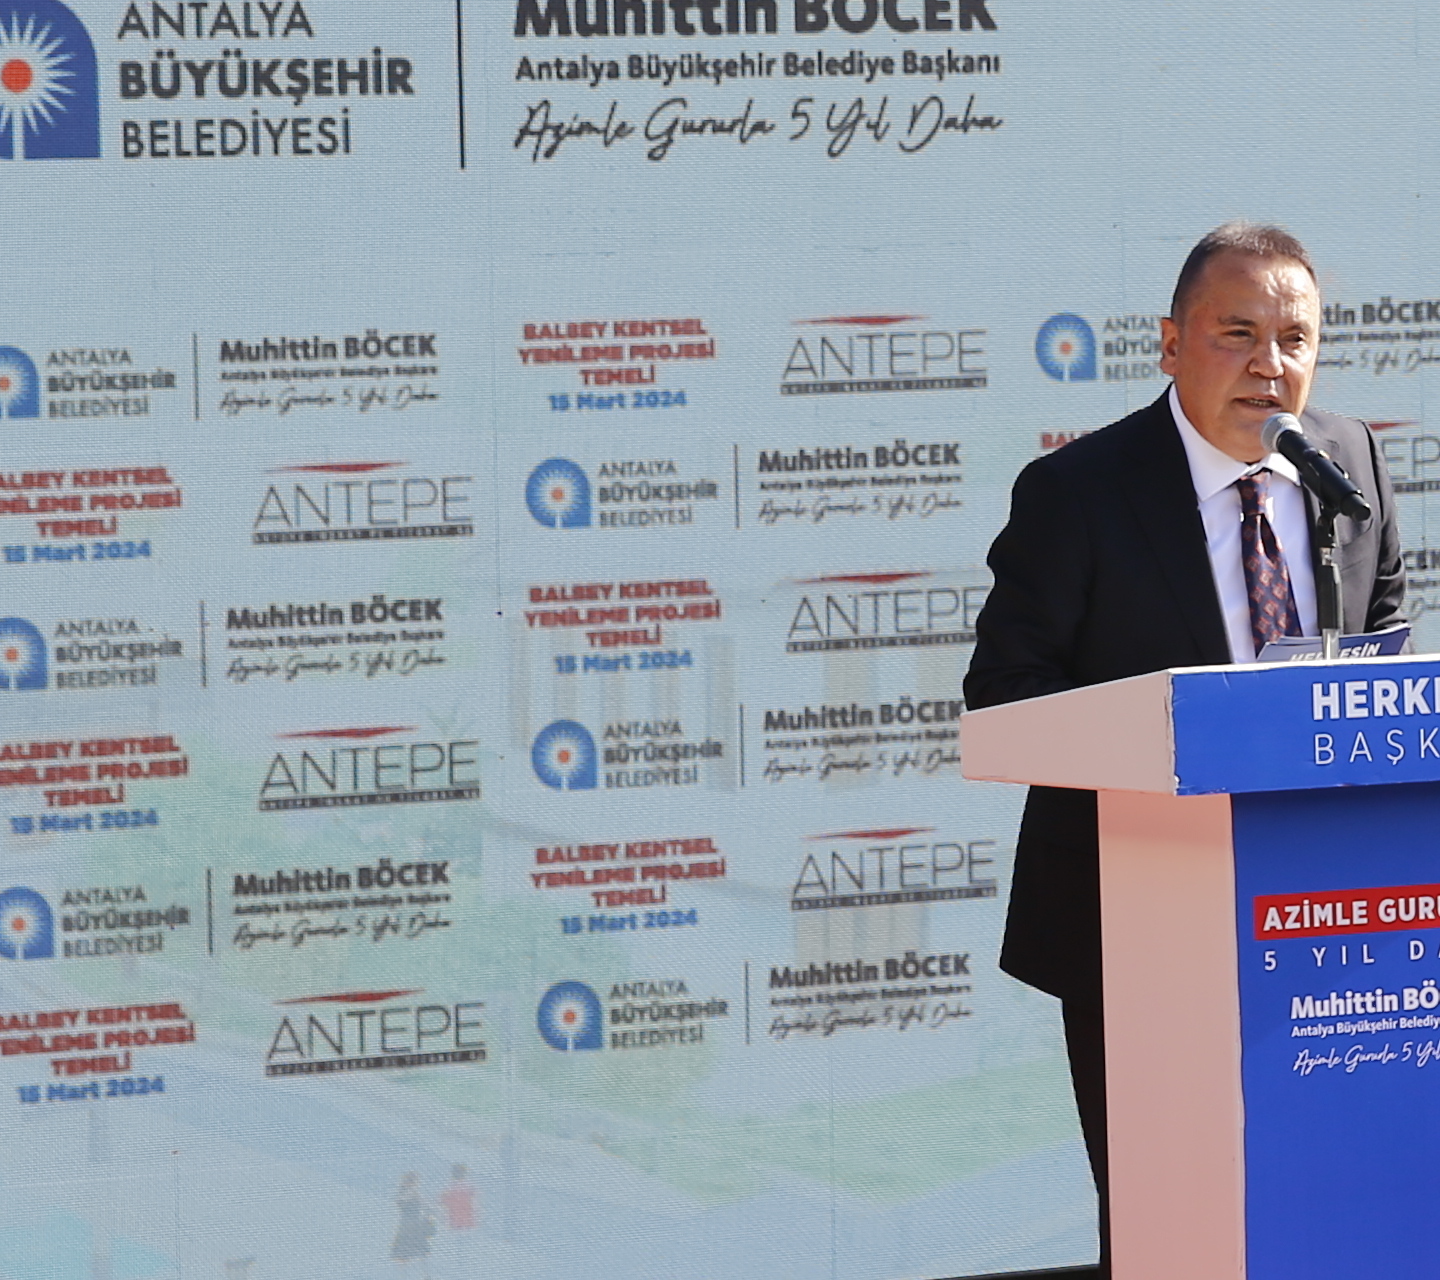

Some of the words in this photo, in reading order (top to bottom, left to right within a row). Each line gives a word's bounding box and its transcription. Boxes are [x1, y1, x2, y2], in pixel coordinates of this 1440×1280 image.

[119, 46, 416, 109] BÜYÜKŞEHİR
[515, 54, 620, 86] Antalya
[628, 53, 777, 86] Büyükşehir
[783, 51, 894, 82] Belediye
[902, 49, 1000, 80] Başkanı
[121, 105, 353, 158] BELEDİYESİ
[514, 99, 635, 162] Azimle
[644, 97, 777, 161] Gururla
[788, 97, 815, 140] 5
[898, 94, 1004, 153] Daha
[1103, 316, 1162, 332] ANTAL
[1362, 296, 1440, 325] BÖCEK
[47, 349, 132, 366] ANTALYA
[219, 338, 338, 363] Muhittin
[344, 328, 436, 359] BÖCEK
[782, 329, 988, 380] ANTEPE
[47, 370, 176, 394] BÜYÜKŞEHİR
[598, 460, 678, 478] ANTALYA
[759, 449, 869, 473] Muhittin
[874, 439, 960, 467] BÖCEK
[253, 477, 473, 527] ANTEPE
[598, 479, 718, 504] BÜYÜKŞEHİR
[54, 619, 138, 638] ANTALYA
[226, 608, 345, 630] Muhittin
[350, 596, 444, 623] BÖCEK
[55, 640, 182, 664] BÜYÜKŞEHİR
[604, 721, 683, 740] ANTALYA
[764, 708, 875, 733] Muhittin
[880, 697, 965, 723] BÖCEK
[261, 741, 480, 795] ANTEPE
[604, 740, 723, 764] BÜYÜKŞEHİR
[232, 872, 352, 897] Muhittin
[358, 858, 449, 887] BÖCEK
[793, 840, 996, 897] ANTEPE
[1263, 900, 1368, 932] AZİMLE
[769, 964, 879, 990] Muhittin
[885, 952, 970, 981] BÖCEK
[1264, 951, 1276, 970] 5
[1312, 944, 1375, 967] YIL
[610, 981, 688, 1000] ANTALYA
[1291, 988, 1399, 1019] Muhittin
[269, 1003, 486, 1062] ANTEPE
[1291, 1024, 1334, 1038] Antalya
[1337, 1019, 1398, 1034] Büyükşehir
[1292, 1048, 1342, 1076] Azimle
[1345, 1044, 1398, 1073] Gururla
[1401, 1042, 1413, 1062] 5
